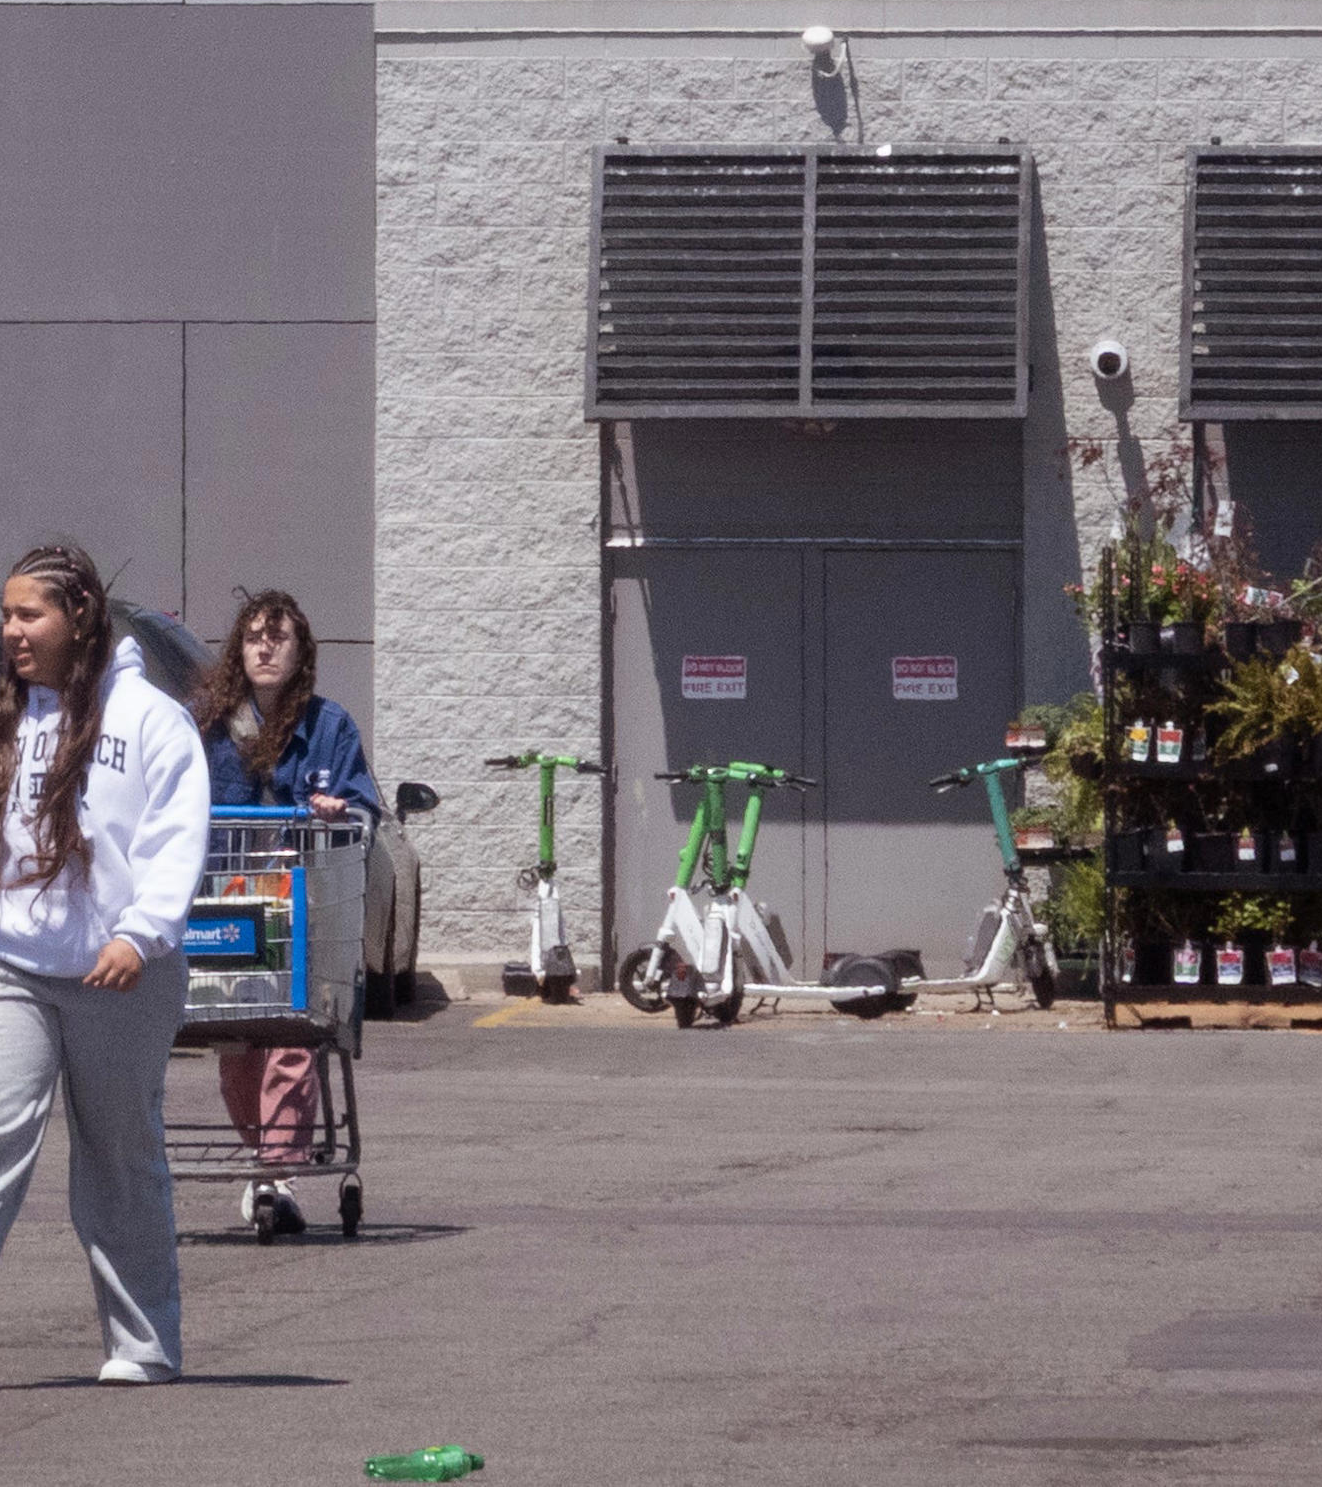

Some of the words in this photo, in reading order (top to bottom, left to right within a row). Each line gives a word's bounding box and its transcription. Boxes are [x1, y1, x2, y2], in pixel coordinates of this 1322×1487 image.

[684, 683, 712, 693] FIRE
[717, 682, 744, 692] EXIT
[895, 683, 924, 693] FIRE
[928, 683, 955, 693] EXIT
[181, 927, 222, 941] almart
